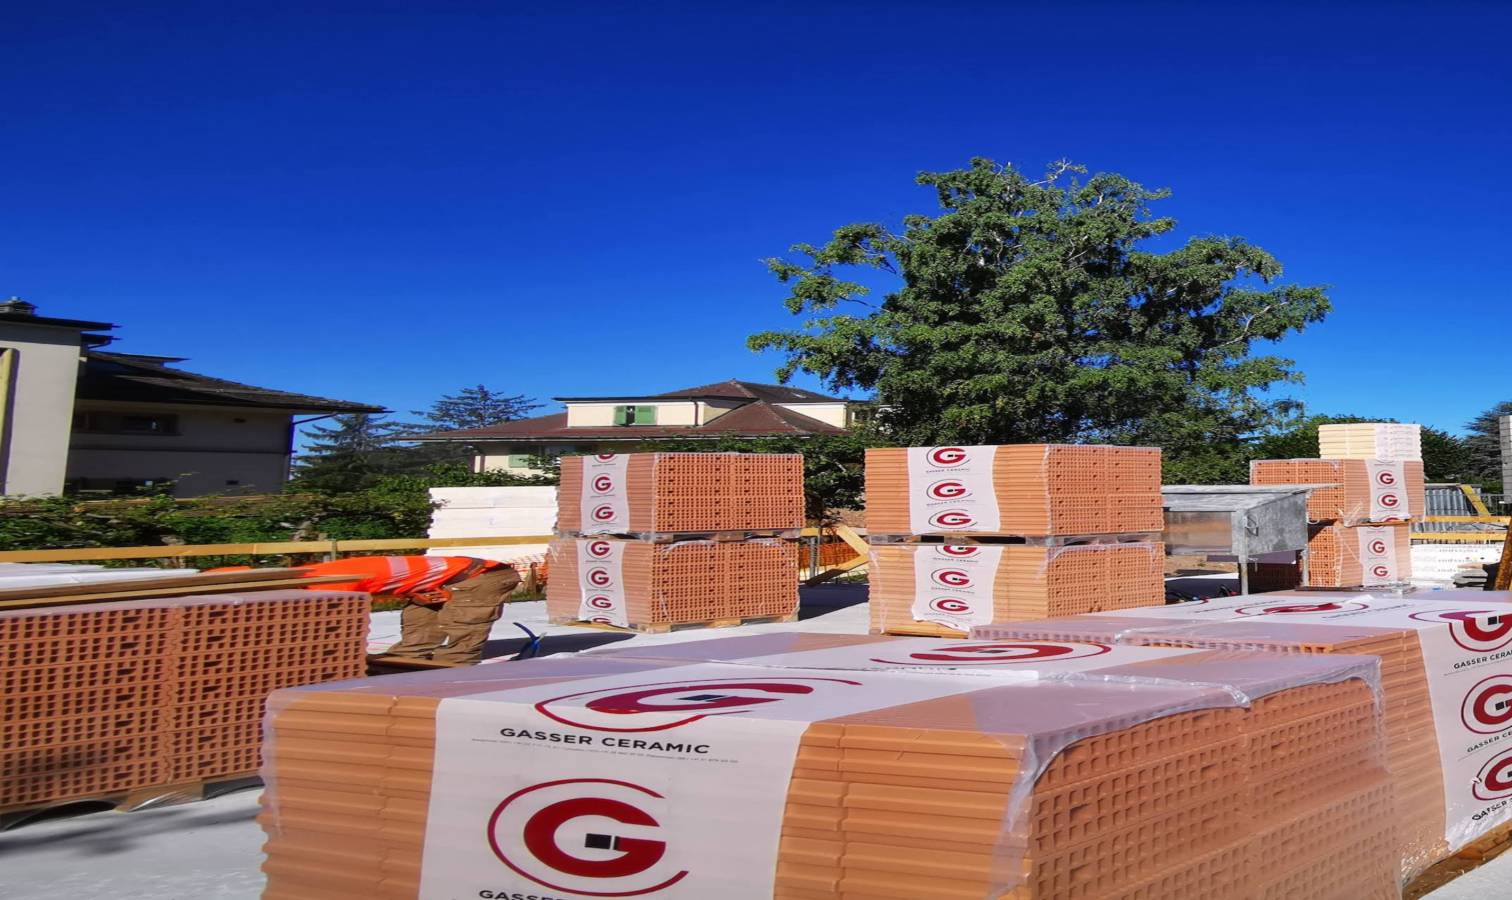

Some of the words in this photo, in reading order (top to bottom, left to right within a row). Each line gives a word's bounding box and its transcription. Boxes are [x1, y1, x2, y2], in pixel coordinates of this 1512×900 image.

[933, 447, 966, 465] G
[933, 482, 966, 498] G
[937, 512, 972, 526] G
[939, 571, 970, 586] G
[937, 599, 969, 612] G
[1453, 656, 1488, 669] GASSER
[586, 682, 814, 714] G
[500, 728, 593, 746] GASSER
[601, 737, 711, 754] CERAMIC
[1467, 735, 1500, 753] GASSER
[524, 797, 667, 878] G
[479, 889, 567, 900] GASS
